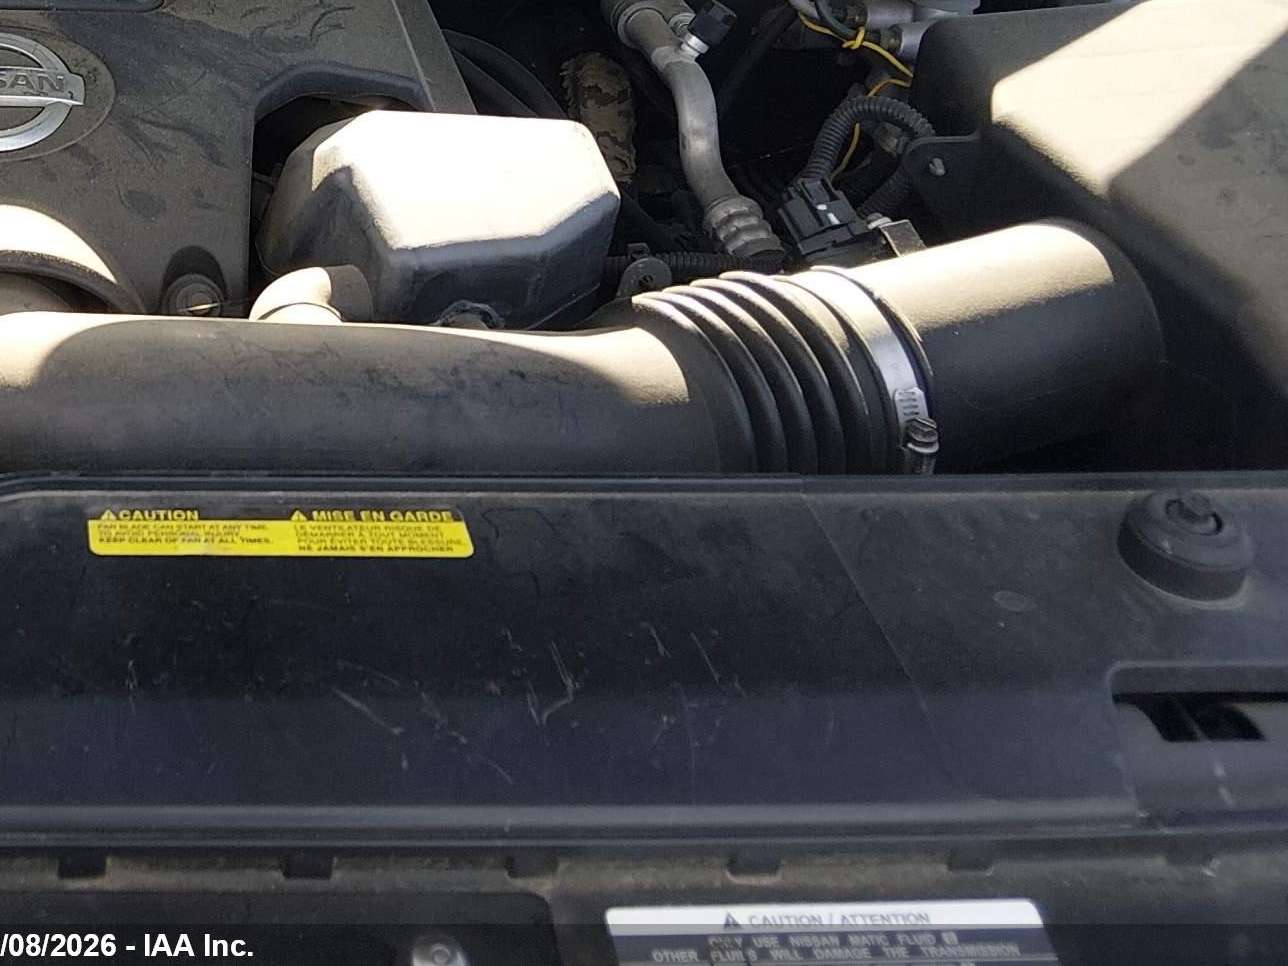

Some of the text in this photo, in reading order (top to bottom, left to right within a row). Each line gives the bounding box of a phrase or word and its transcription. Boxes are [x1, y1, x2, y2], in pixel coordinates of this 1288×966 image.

[119, 509, 199, 521] CAUTION
[312, 510, 454, 522] MISE EN GARDE
[749, 914, 823, 928] CAUTION
[840, 913, 931, 926] ATTENTION
[751, 936, 780, 948] USE
[787, 935, 840, 948] NISSAN
[848, 933, 890, 946] MATIC
[896, 933, 937, 945] FLUID
[650, 949, 700, 963] OTHER
[769, 948, 803, 961] WILL
[813, 947, 872, 960] DAMAGE
[881, 946, 911, 958] THE
[920, 942, 1021, 958] TRANSMISSION
